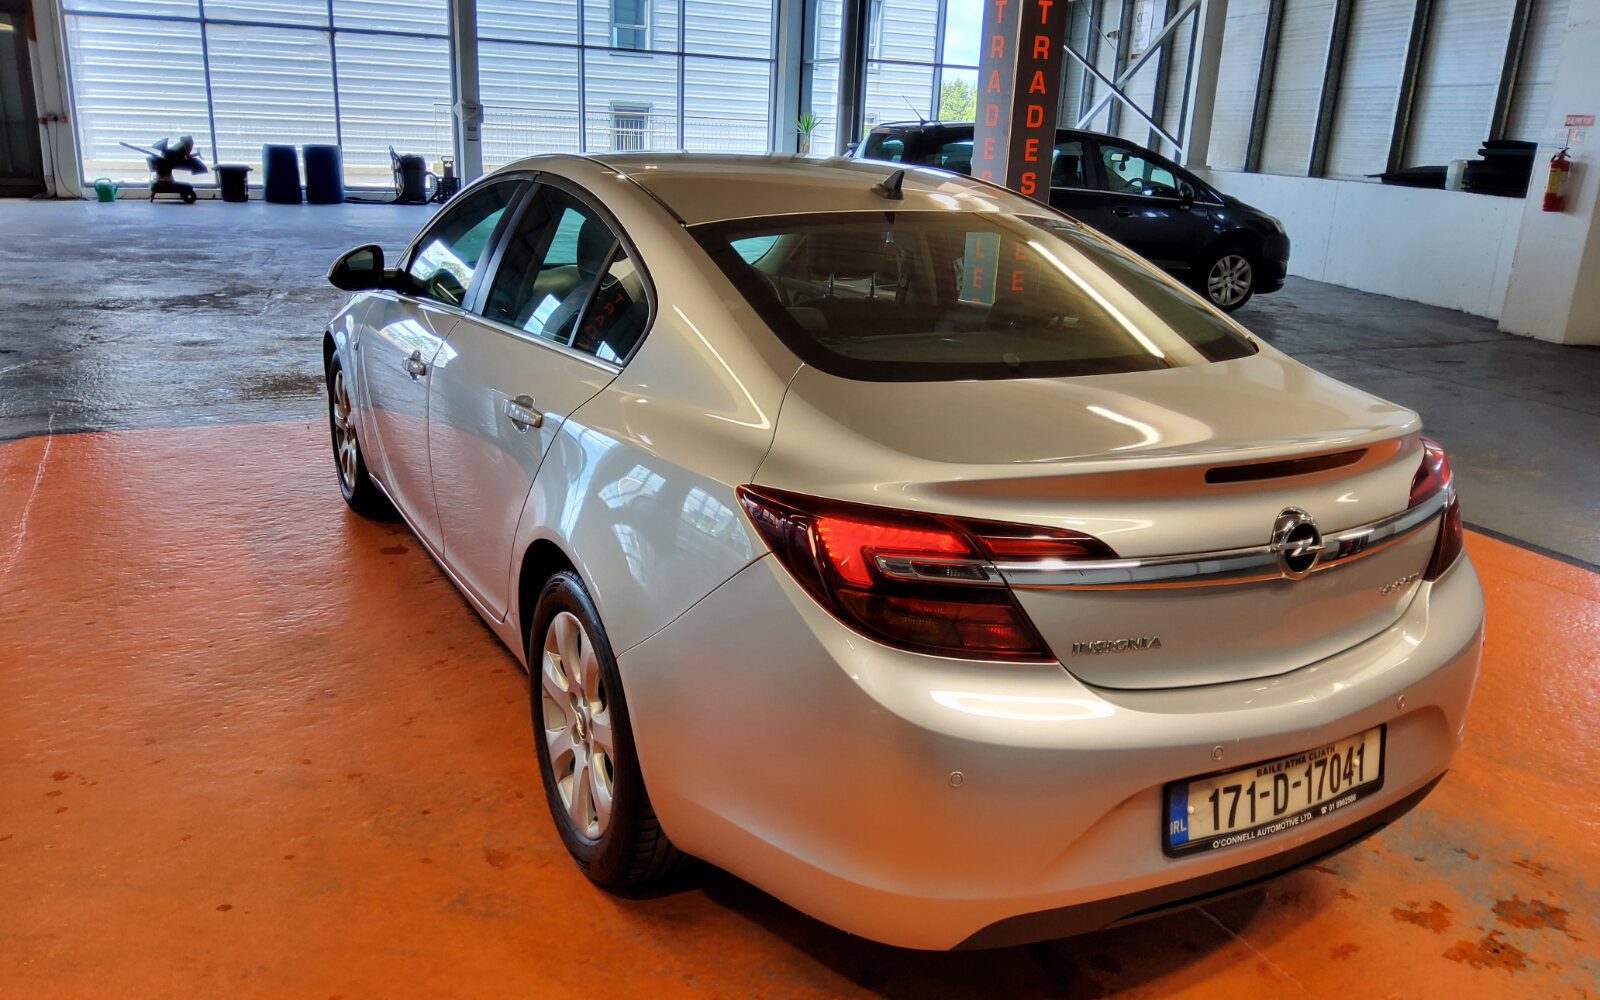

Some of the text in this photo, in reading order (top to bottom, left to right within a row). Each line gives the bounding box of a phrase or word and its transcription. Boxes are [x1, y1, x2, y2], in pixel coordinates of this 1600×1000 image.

[1071, 635, 1162, 656] INSIGNIA
[1256, 763, 1282, 777] BAILE
[1308, 745, 1336, 761] CLIATH
[1208, 742, 1366, 832] 171-D-17041
[1170, 819, 1187, 836] IRL
[1212, 831, 1256, 849] O'CONNELL
[1256, 817, 1300, 837] AUTOMOTIVE
